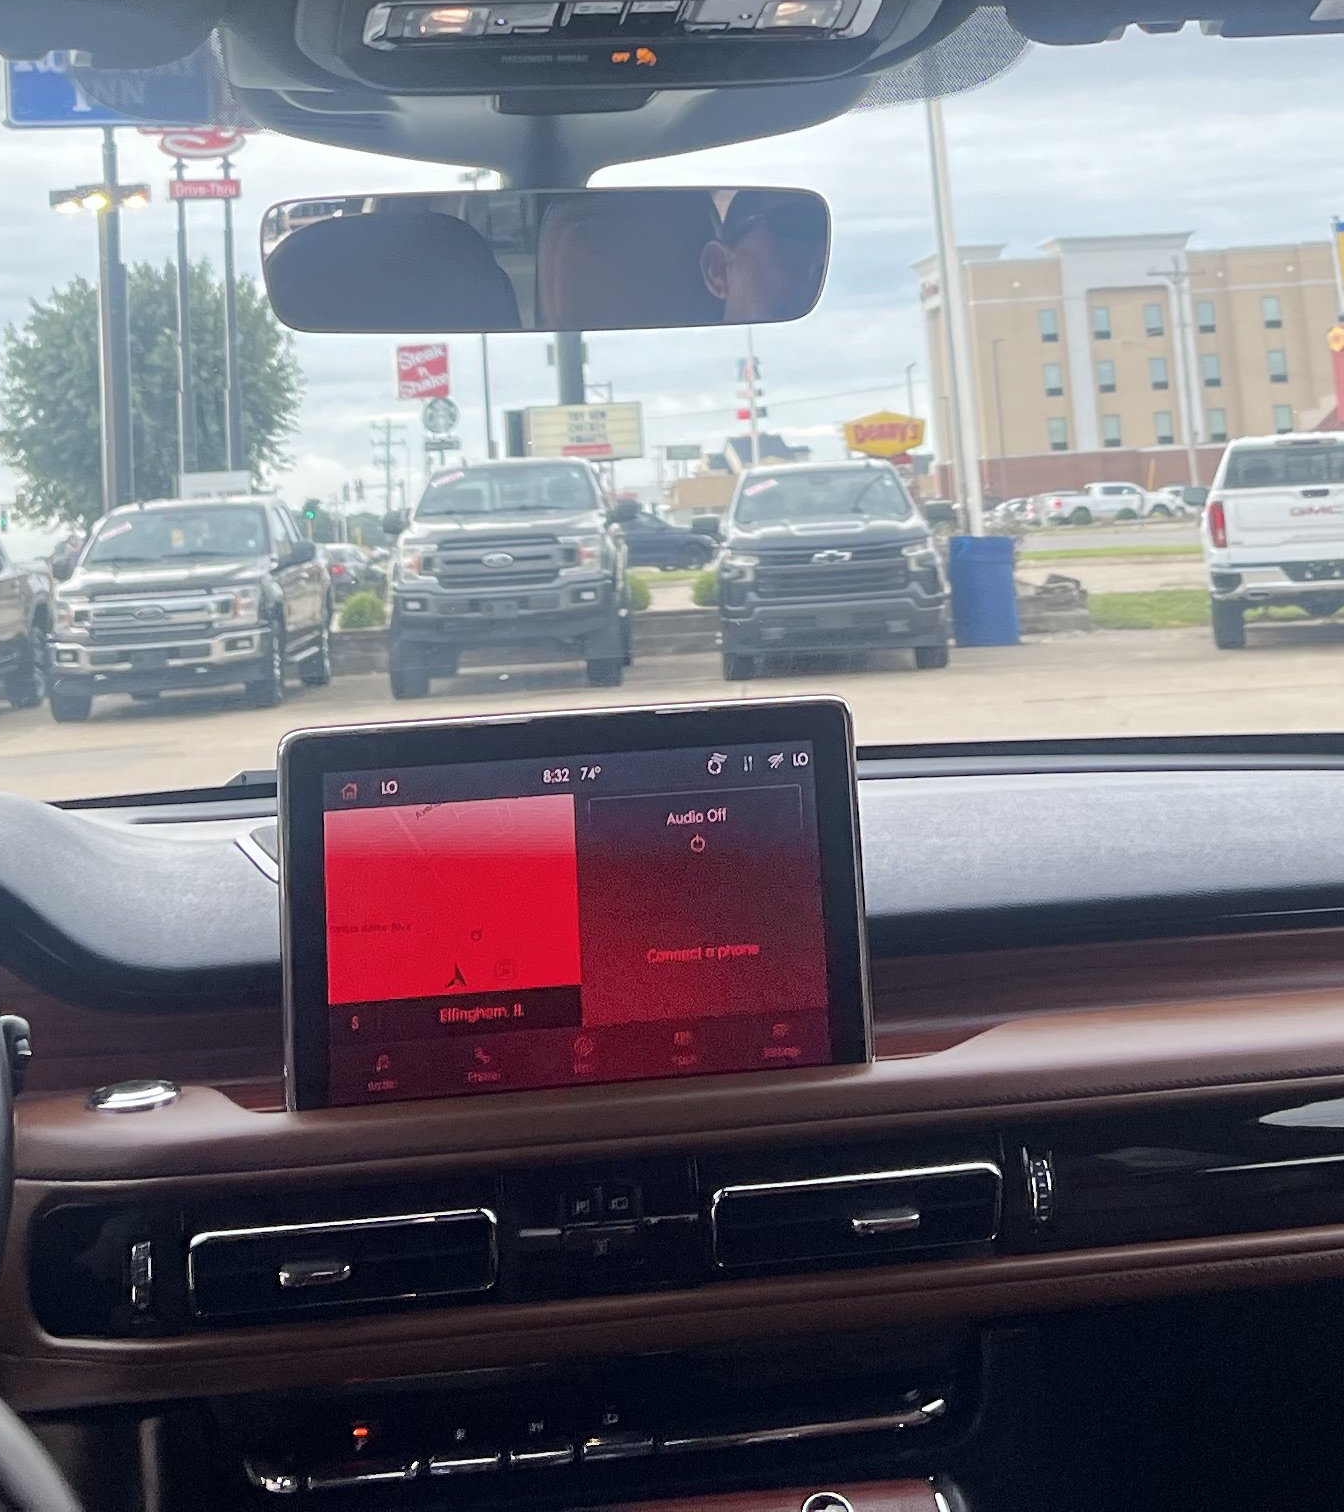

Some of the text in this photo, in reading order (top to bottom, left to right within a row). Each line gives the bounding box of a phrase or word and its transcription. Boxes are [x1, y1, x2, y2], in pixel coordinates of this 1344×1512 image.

[381, 780, 398, 795] LO
[542, 767, 570, 784] 8:32
[792, 752, 809, 767] LO
[666, 807, 727, 826] Audio Off
